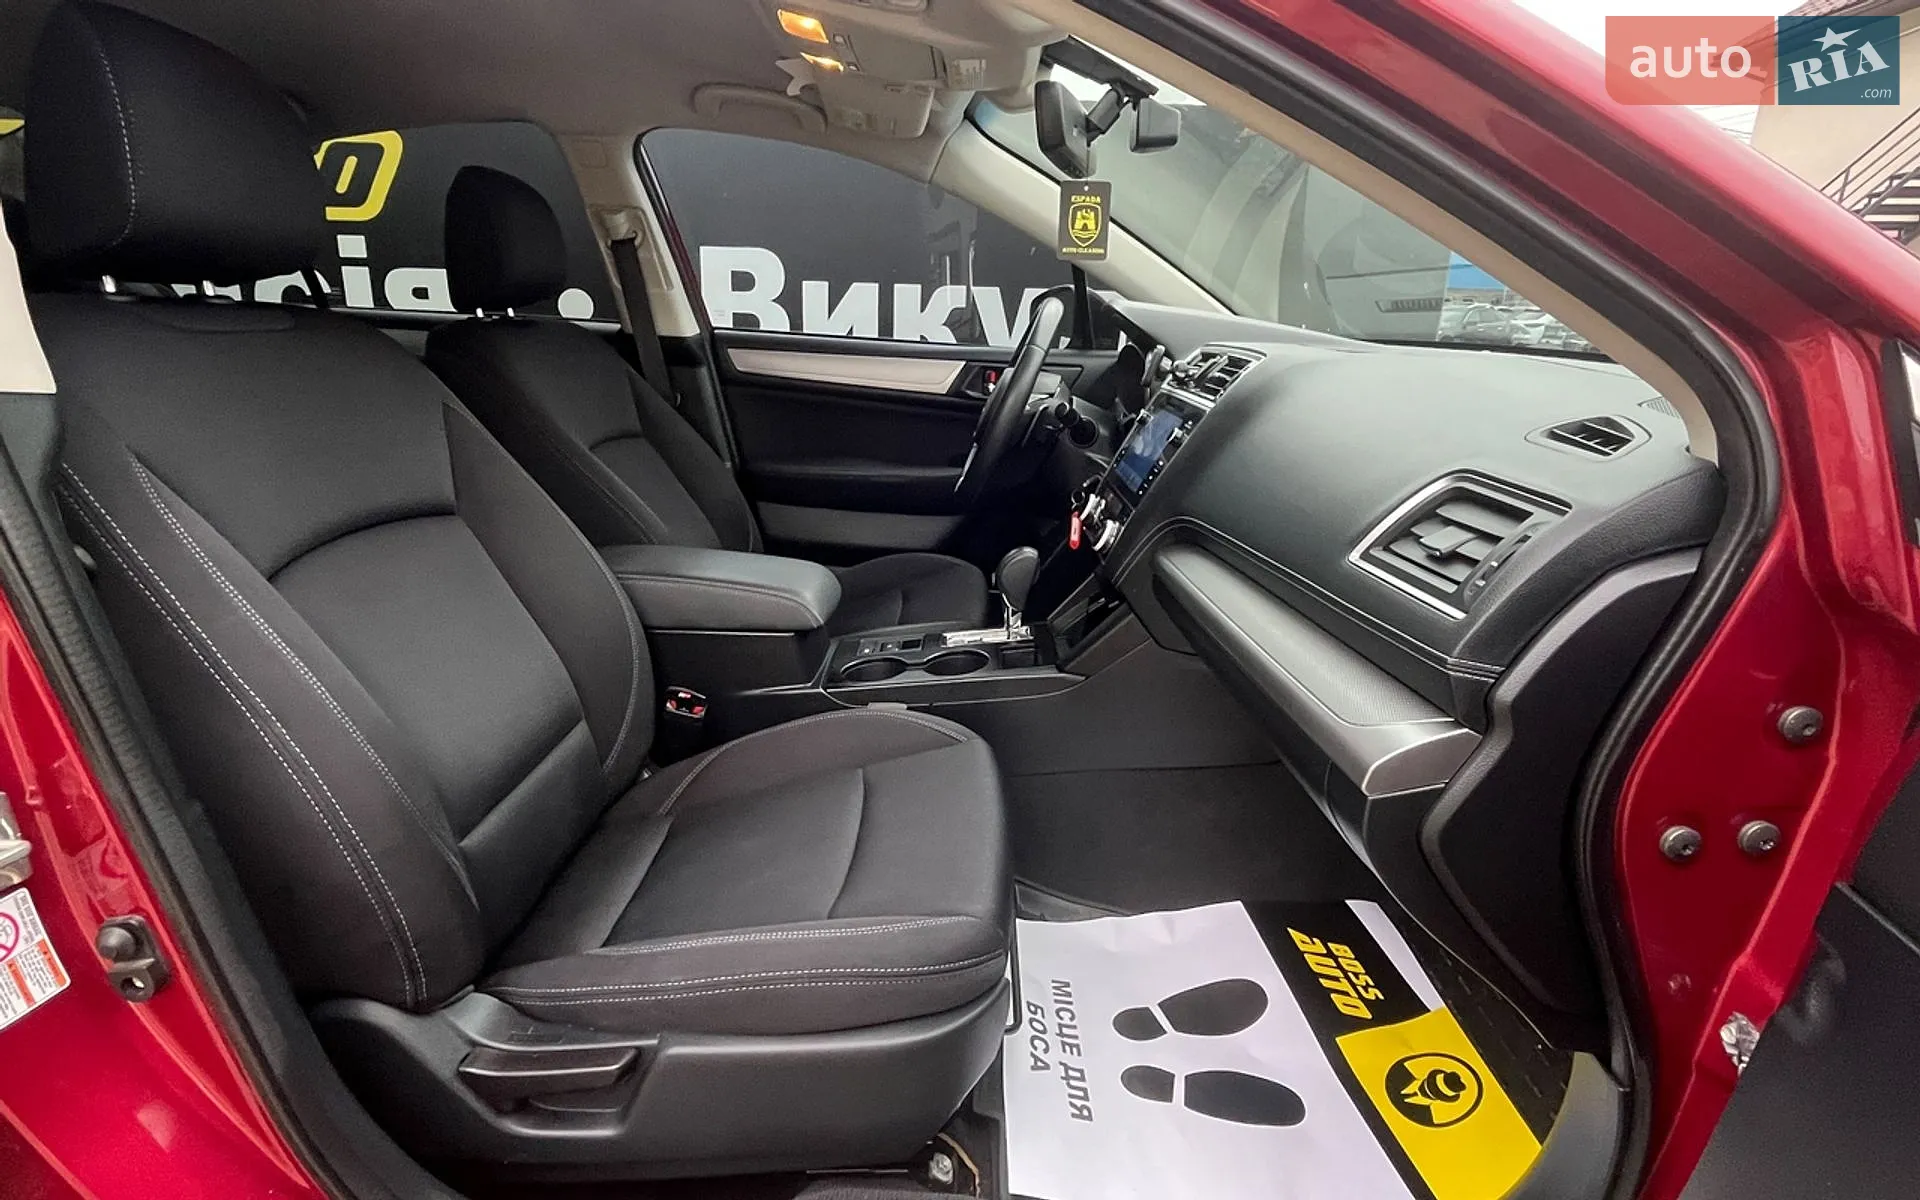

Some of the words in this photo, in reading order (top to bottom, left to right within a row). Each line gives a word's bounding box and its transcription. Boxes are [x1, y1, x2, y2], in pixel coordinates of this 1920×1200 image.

[1071, 195, 1101, 203] ESPADA
[1326, 942, 1385, 1001] BOSS
[1026, 1000, 1052, 1071] БОСА
[1051, 979, 1082, 1057] МІСЦЕ
[1058, 1060, 1094, 1122] ДЛЯ
